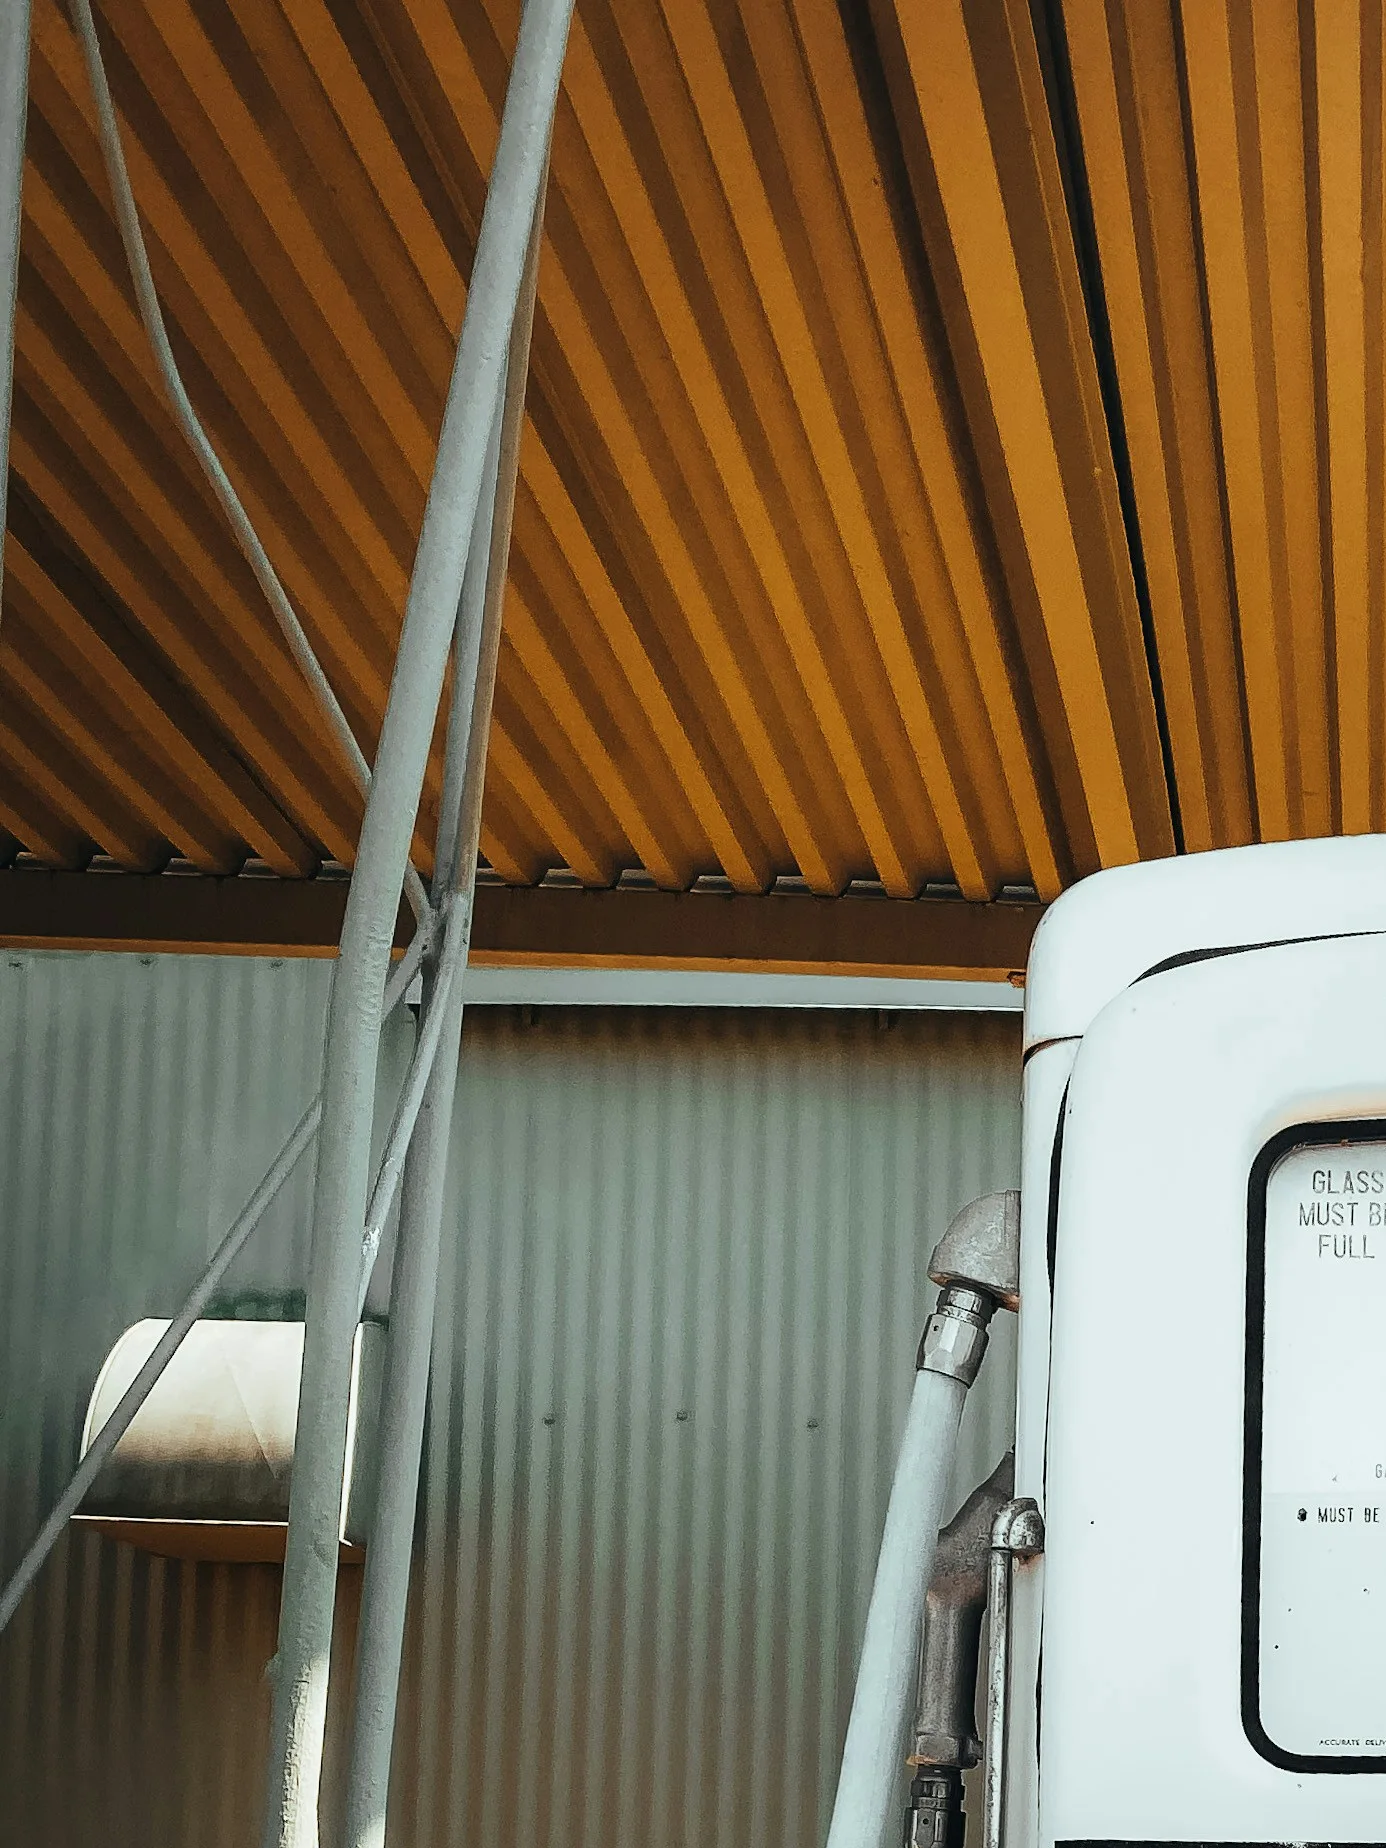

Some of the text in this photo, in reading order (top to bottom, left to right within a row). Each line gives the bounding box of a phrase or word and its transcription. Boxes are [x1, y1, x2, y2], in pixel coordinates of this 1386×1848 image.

[1312, 1169, 1384, 1195] GLASS
[1299, 1201, 1359, 1227] MUST
[1318, 1234, 1375, 1259] FULL
[1318, 1506, 1354, 1523] MUST
[1364, 1507, 1379, 1523] BE
